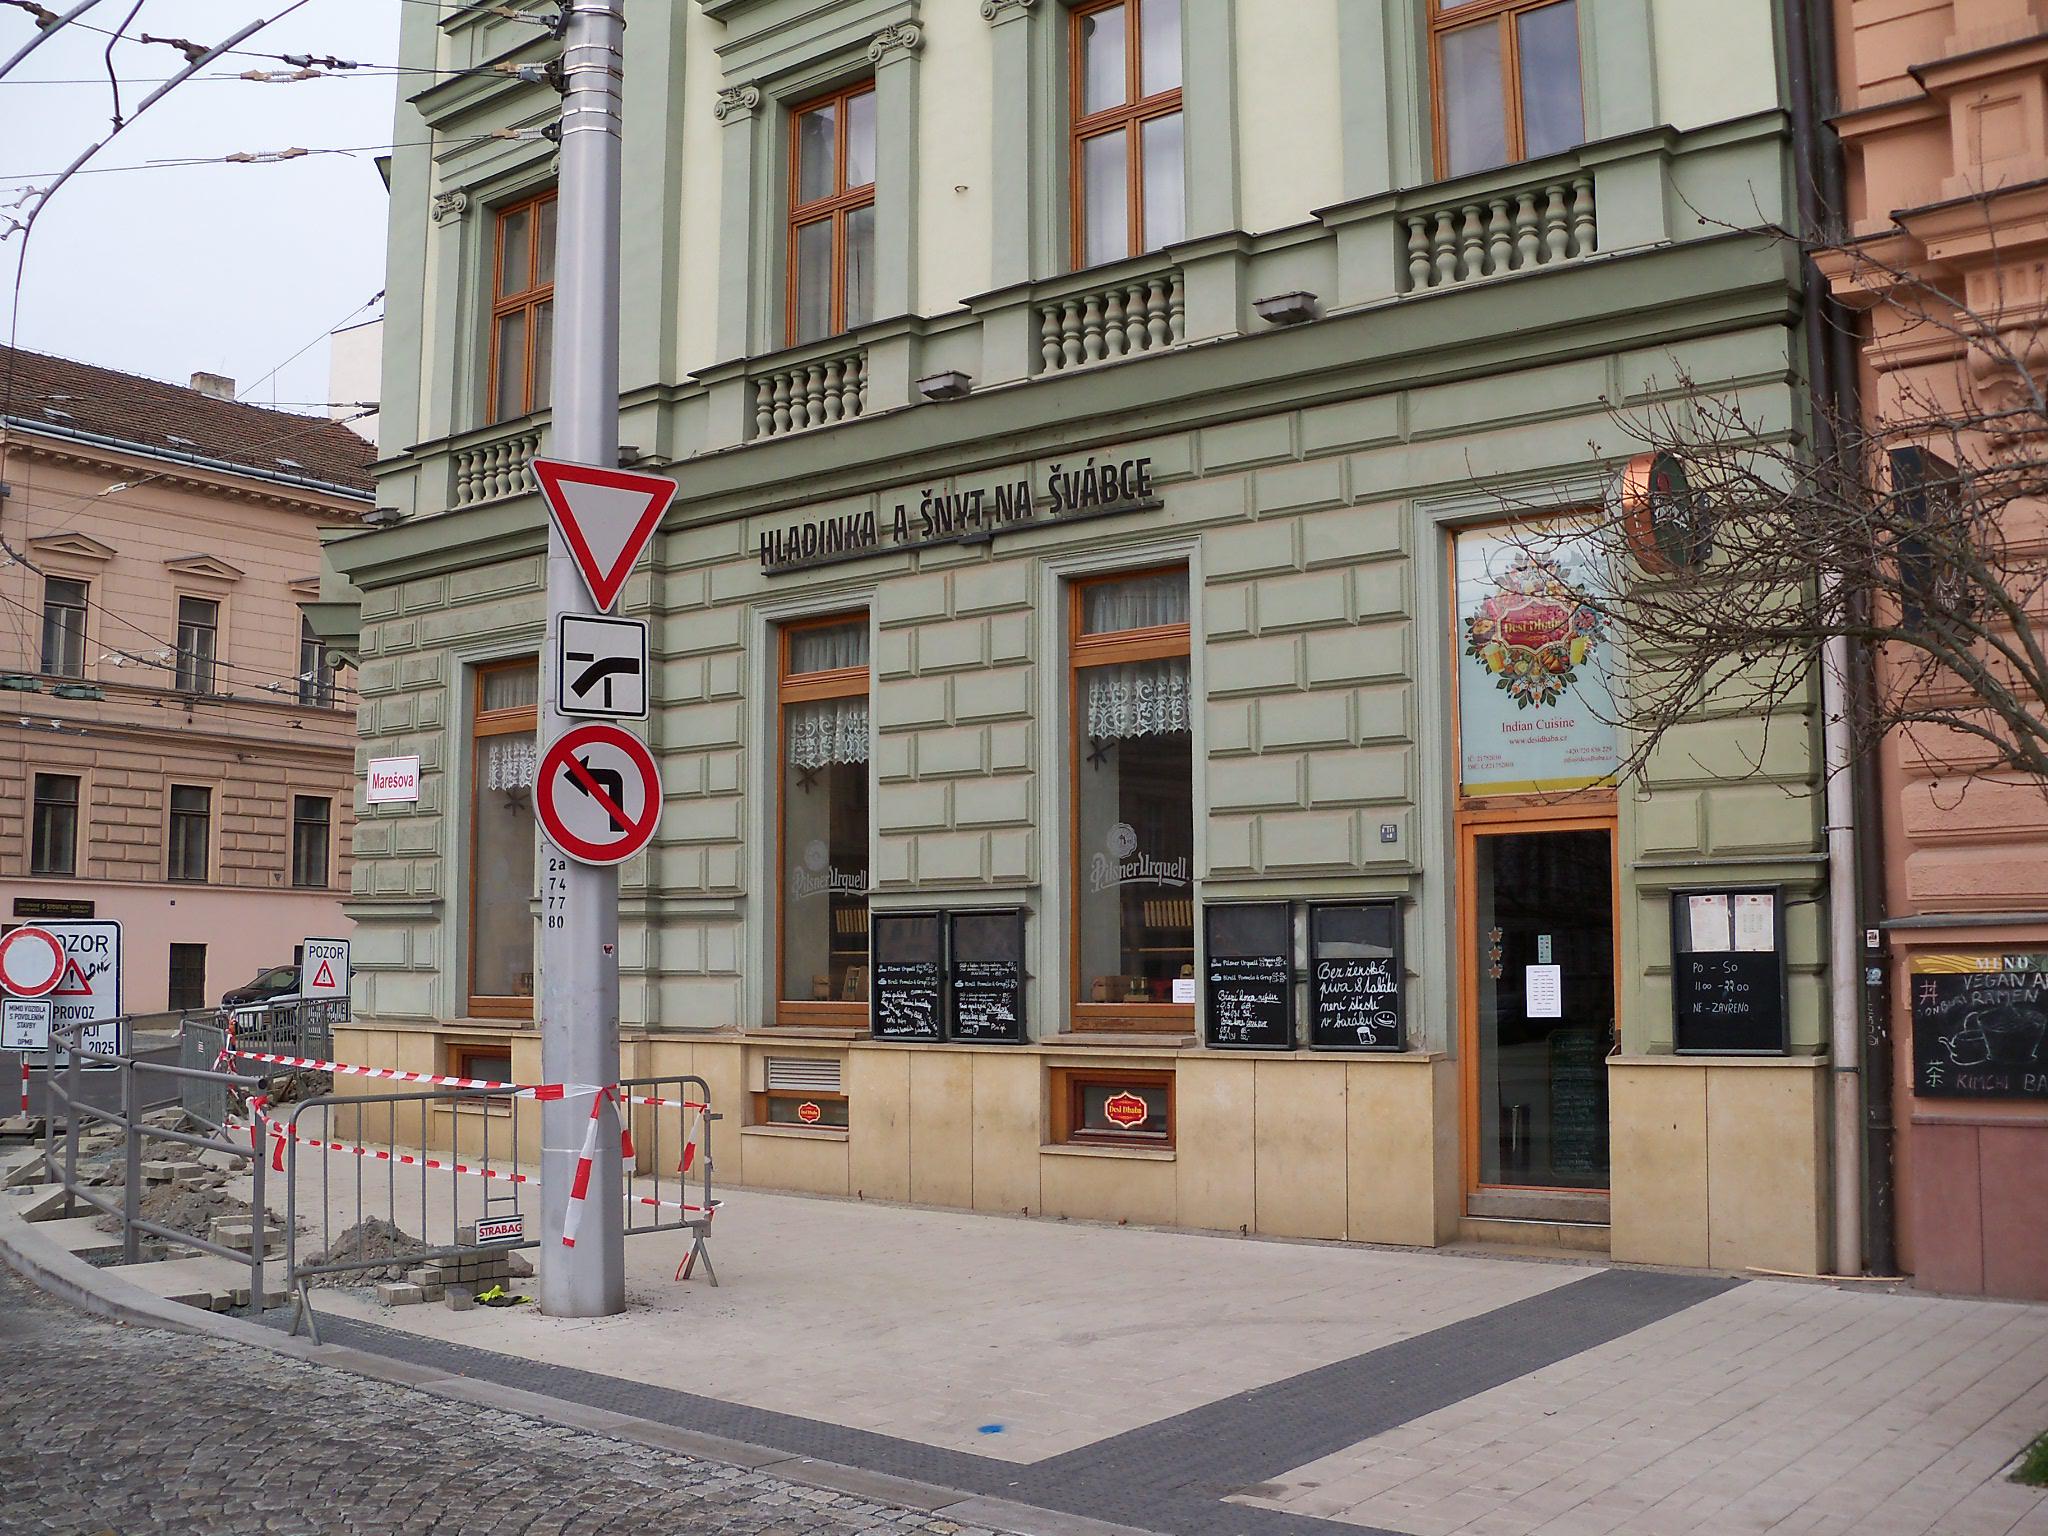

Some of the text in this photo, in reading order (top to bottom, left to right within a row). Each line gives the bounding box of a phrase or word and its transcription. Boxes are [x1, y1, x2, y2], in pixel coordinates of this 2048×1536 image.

[760, 457, 1154, 567] HLADINKA A ŠNYT NA ŠVÁBCE
[1502, 717, 1575, 733] Indian Cuisine
[373, 772, 414, 789] Marešova
[549, 858, 566, 871] 2a
[1138, 851, 1186, 887] Urquell
[549, 877, 566, 890] 74
[548, 896, 566, 909] 77
[548, 915, 564, 928] 80
[56, 934, 108, 952] OZOR
[309, 945, 345, 959] POZOR
[1693, 962, 1703, 973] PO
[1975, 956, 2029, 969] MENU
[1317, 961, 1344, 979] Bez
[1964, 972, 2048, 990] VEGAN A
[1319, 981, 1352, 1001] piva
[1972, 989, 2039, 1006] RAMEN
[24, 1005, 46, 1013] VOZIDLA
[1319, 995, 1346, 1012] není
[1693, 1002, 1702, 1013] NE
[1711, 999, 1749, 1013] ZAVŘENO
[53, 1006, 95, 1019] PROVOZ
[1334, 1011, 1377, 1029] baráku
[89, 1041, 114, 1055] 2025
[1109, 1105, 1142, 1114] Desi Dhaba
[479, 1223, 522, 1237] STRABAG
